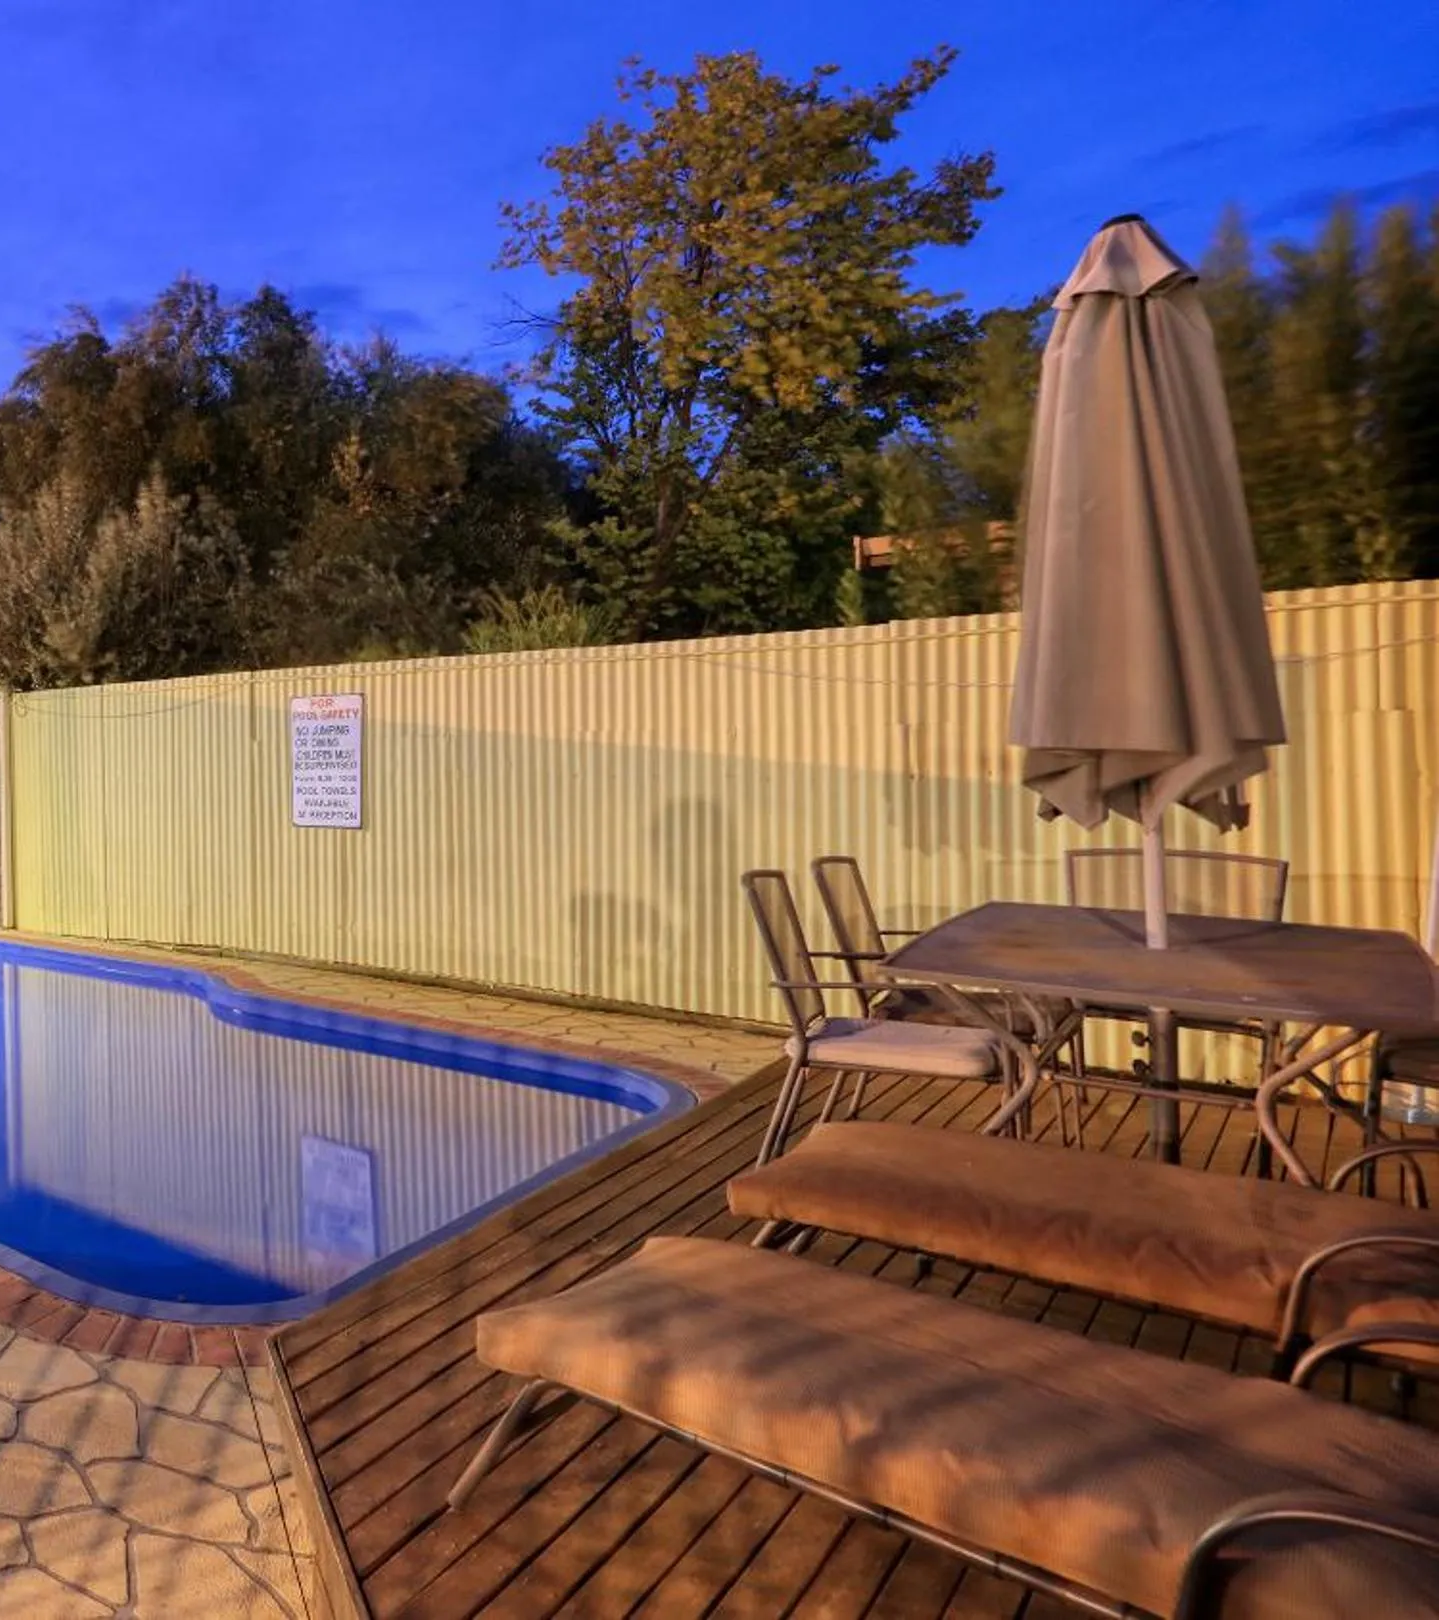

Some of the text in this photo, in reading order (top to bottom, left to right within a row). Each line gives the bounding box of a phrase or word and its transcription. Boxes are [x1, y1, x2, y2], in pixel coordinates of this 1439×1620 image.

[310, 698, 335, 708] FOR
[293, 708, 359, 721] POOL SAFETY
[312, 724, 350, 736] JUMPING
[296, 786, 357, 796] POOL TOWELS
